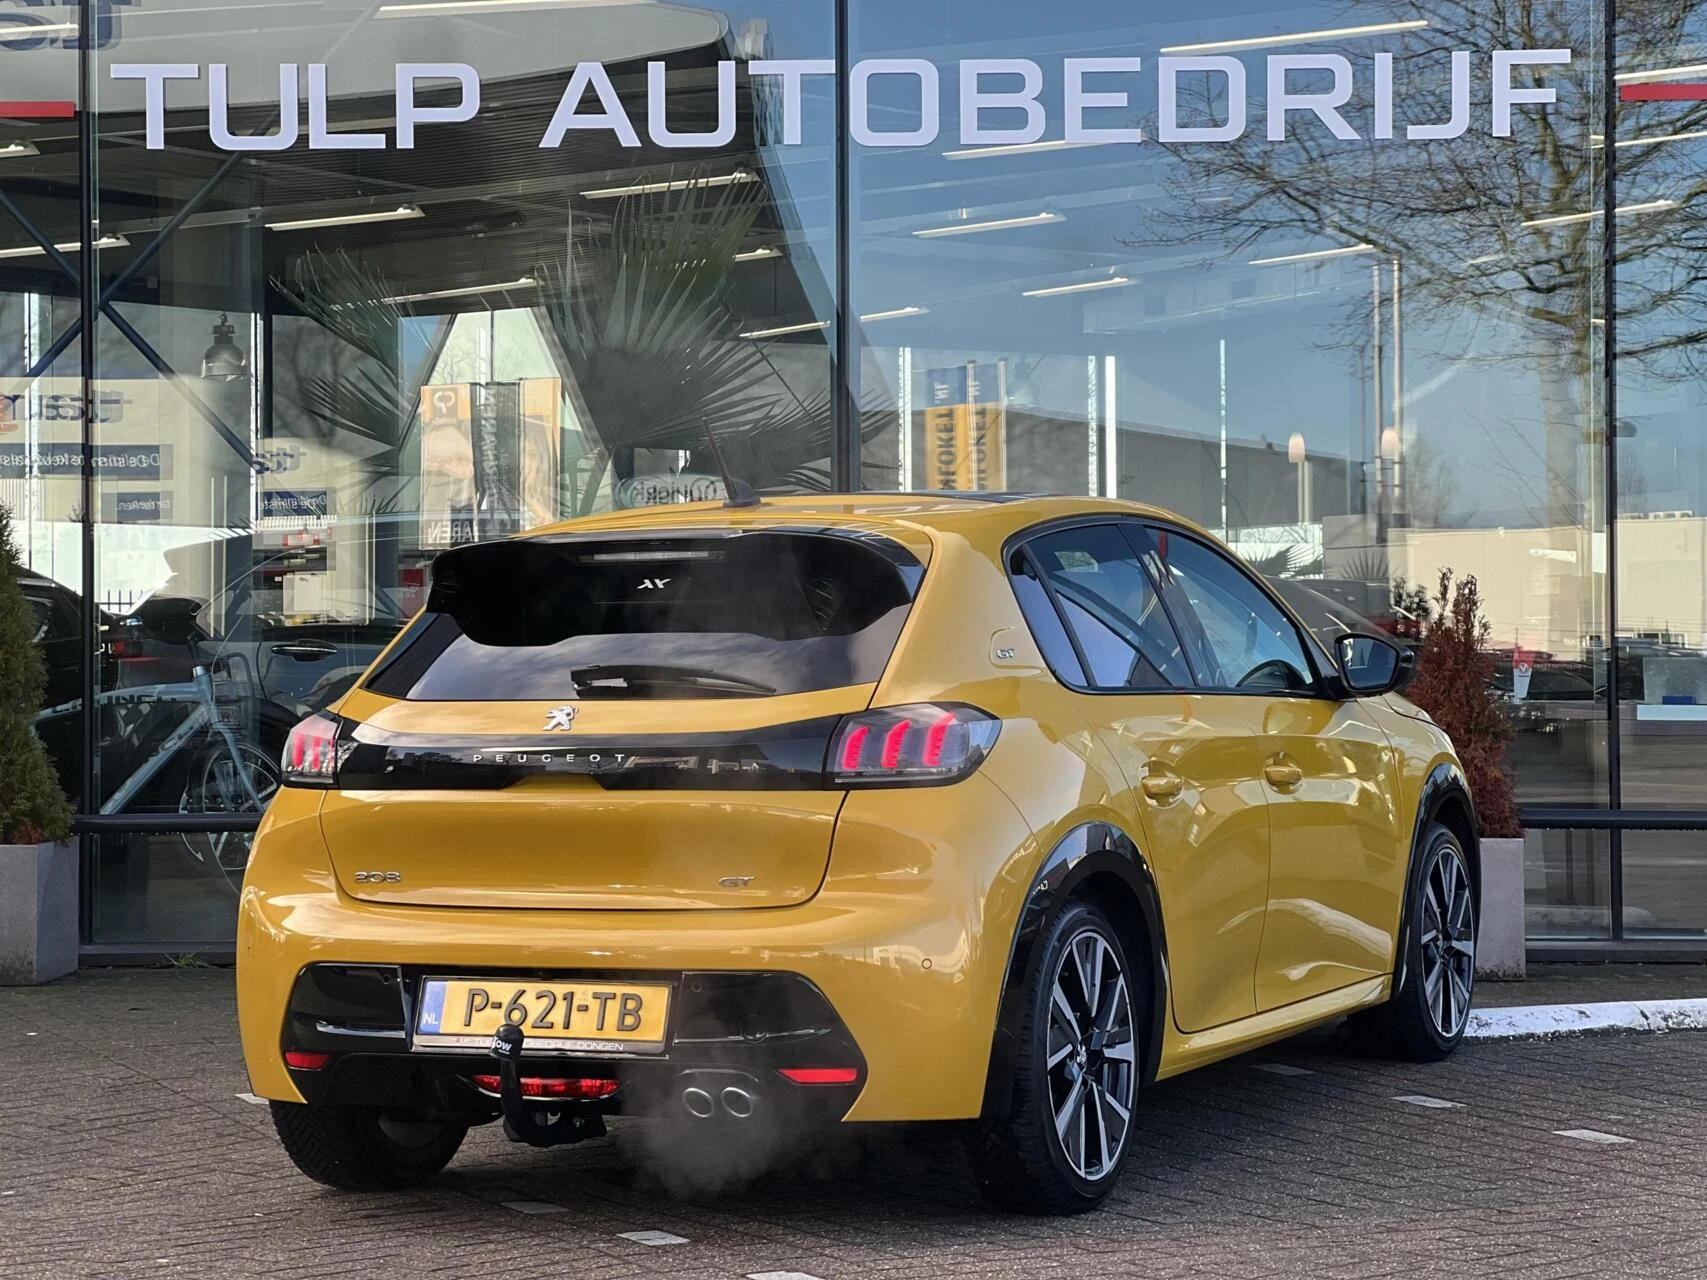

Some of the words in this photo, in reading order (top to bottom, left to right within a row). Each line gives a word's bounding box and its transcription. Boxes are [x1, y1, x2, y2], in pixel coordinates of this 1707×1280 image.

[111, 63, 480, 150] TULP
[538, 48, 1571, 149] AUTOBEDRIJF
[473, 753, 625, 763] PEUGEOT
[354, 871, 401, 883] 208
[718, 876, 756, 889] GT
[464, 987, 643, 1032] P-621-TB
[423, 1013, 439, 1025] NL
[576, 1041, 623, 1051] DONGEN
